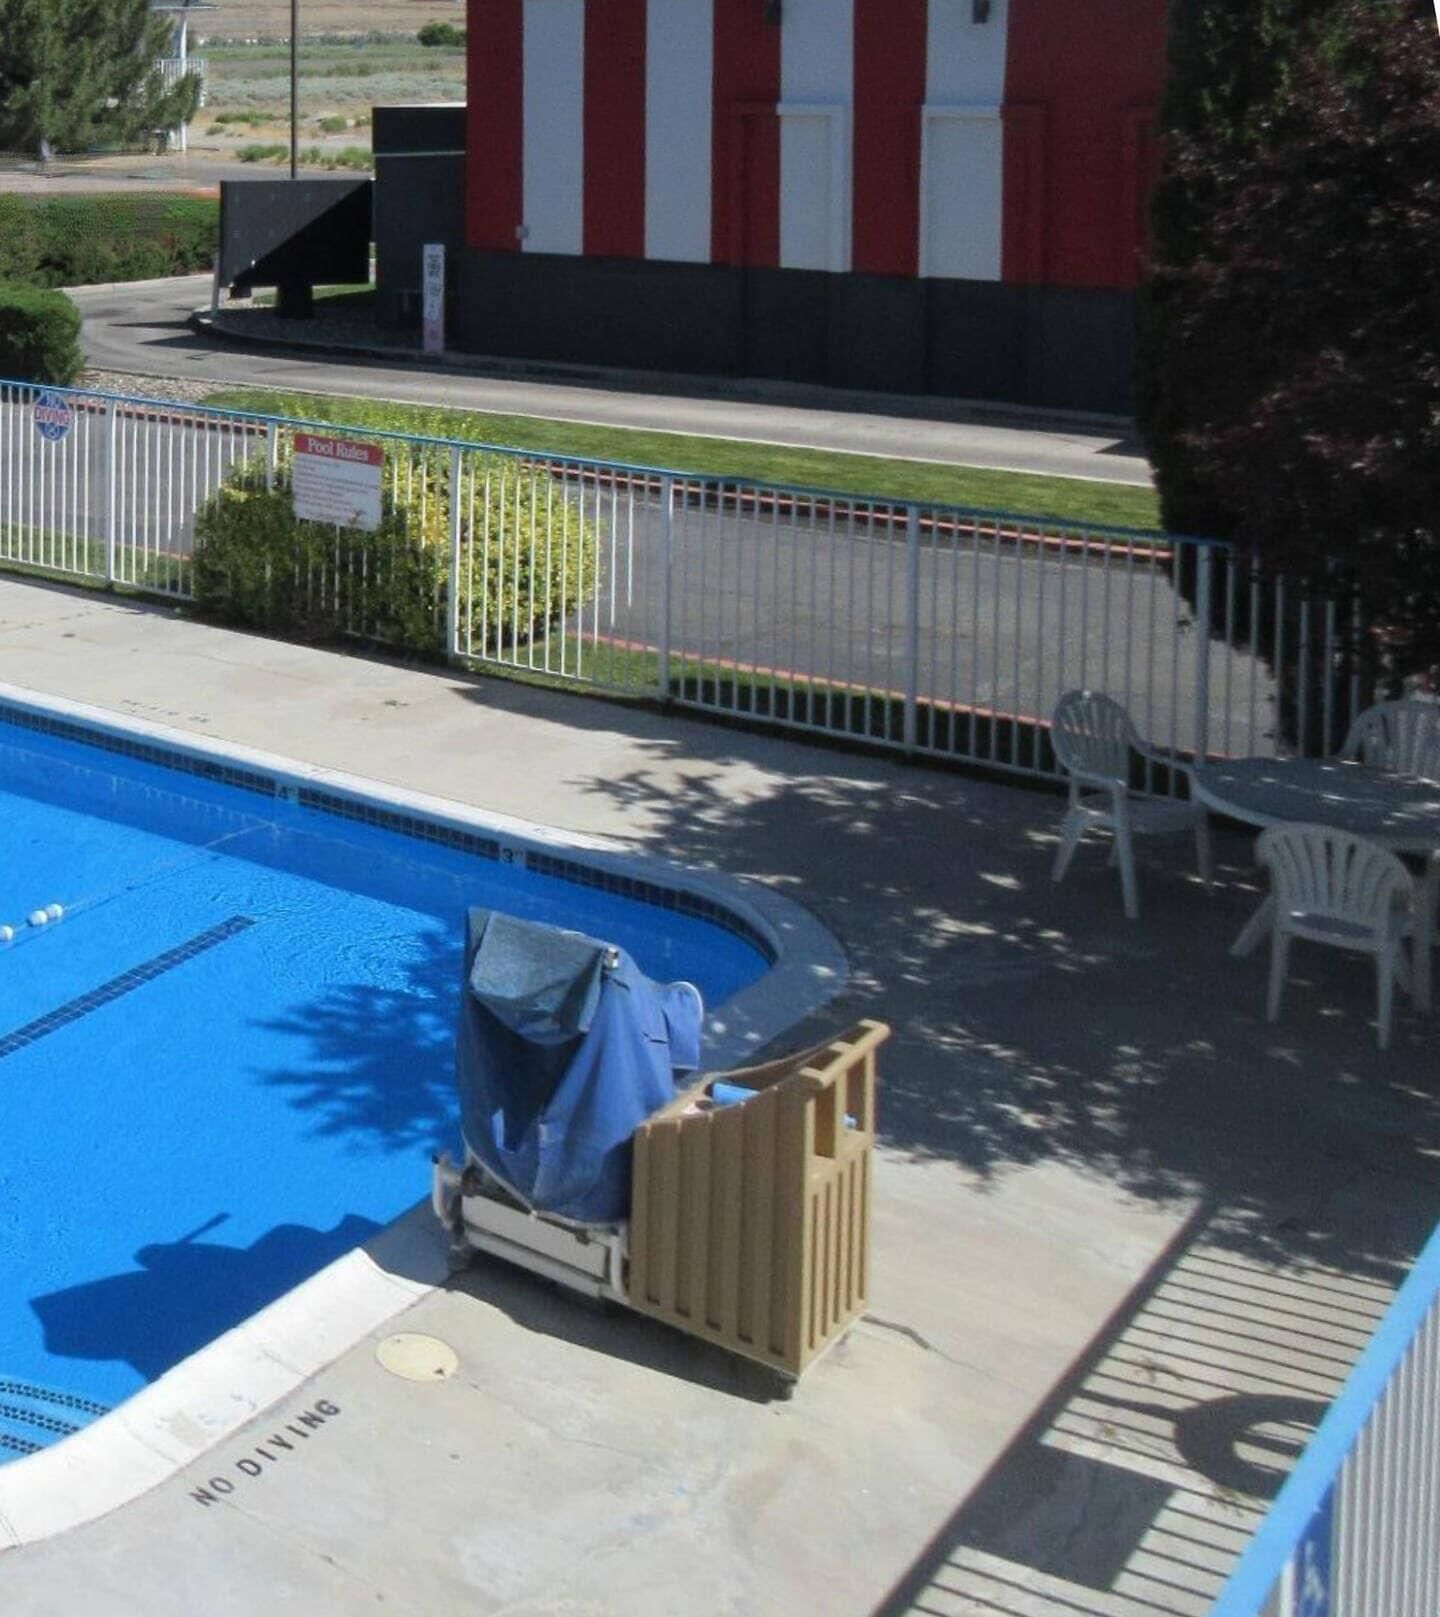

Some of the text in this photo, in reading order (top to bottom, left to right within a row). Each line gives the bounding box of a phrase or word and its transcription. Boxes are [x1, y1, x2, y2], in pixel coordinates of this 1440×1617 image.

[35, 407, 71, 425] DIVING
[307, 438, 369, 461] Pool Rules
[189, 1399, 341, 1507] NO DIVING
